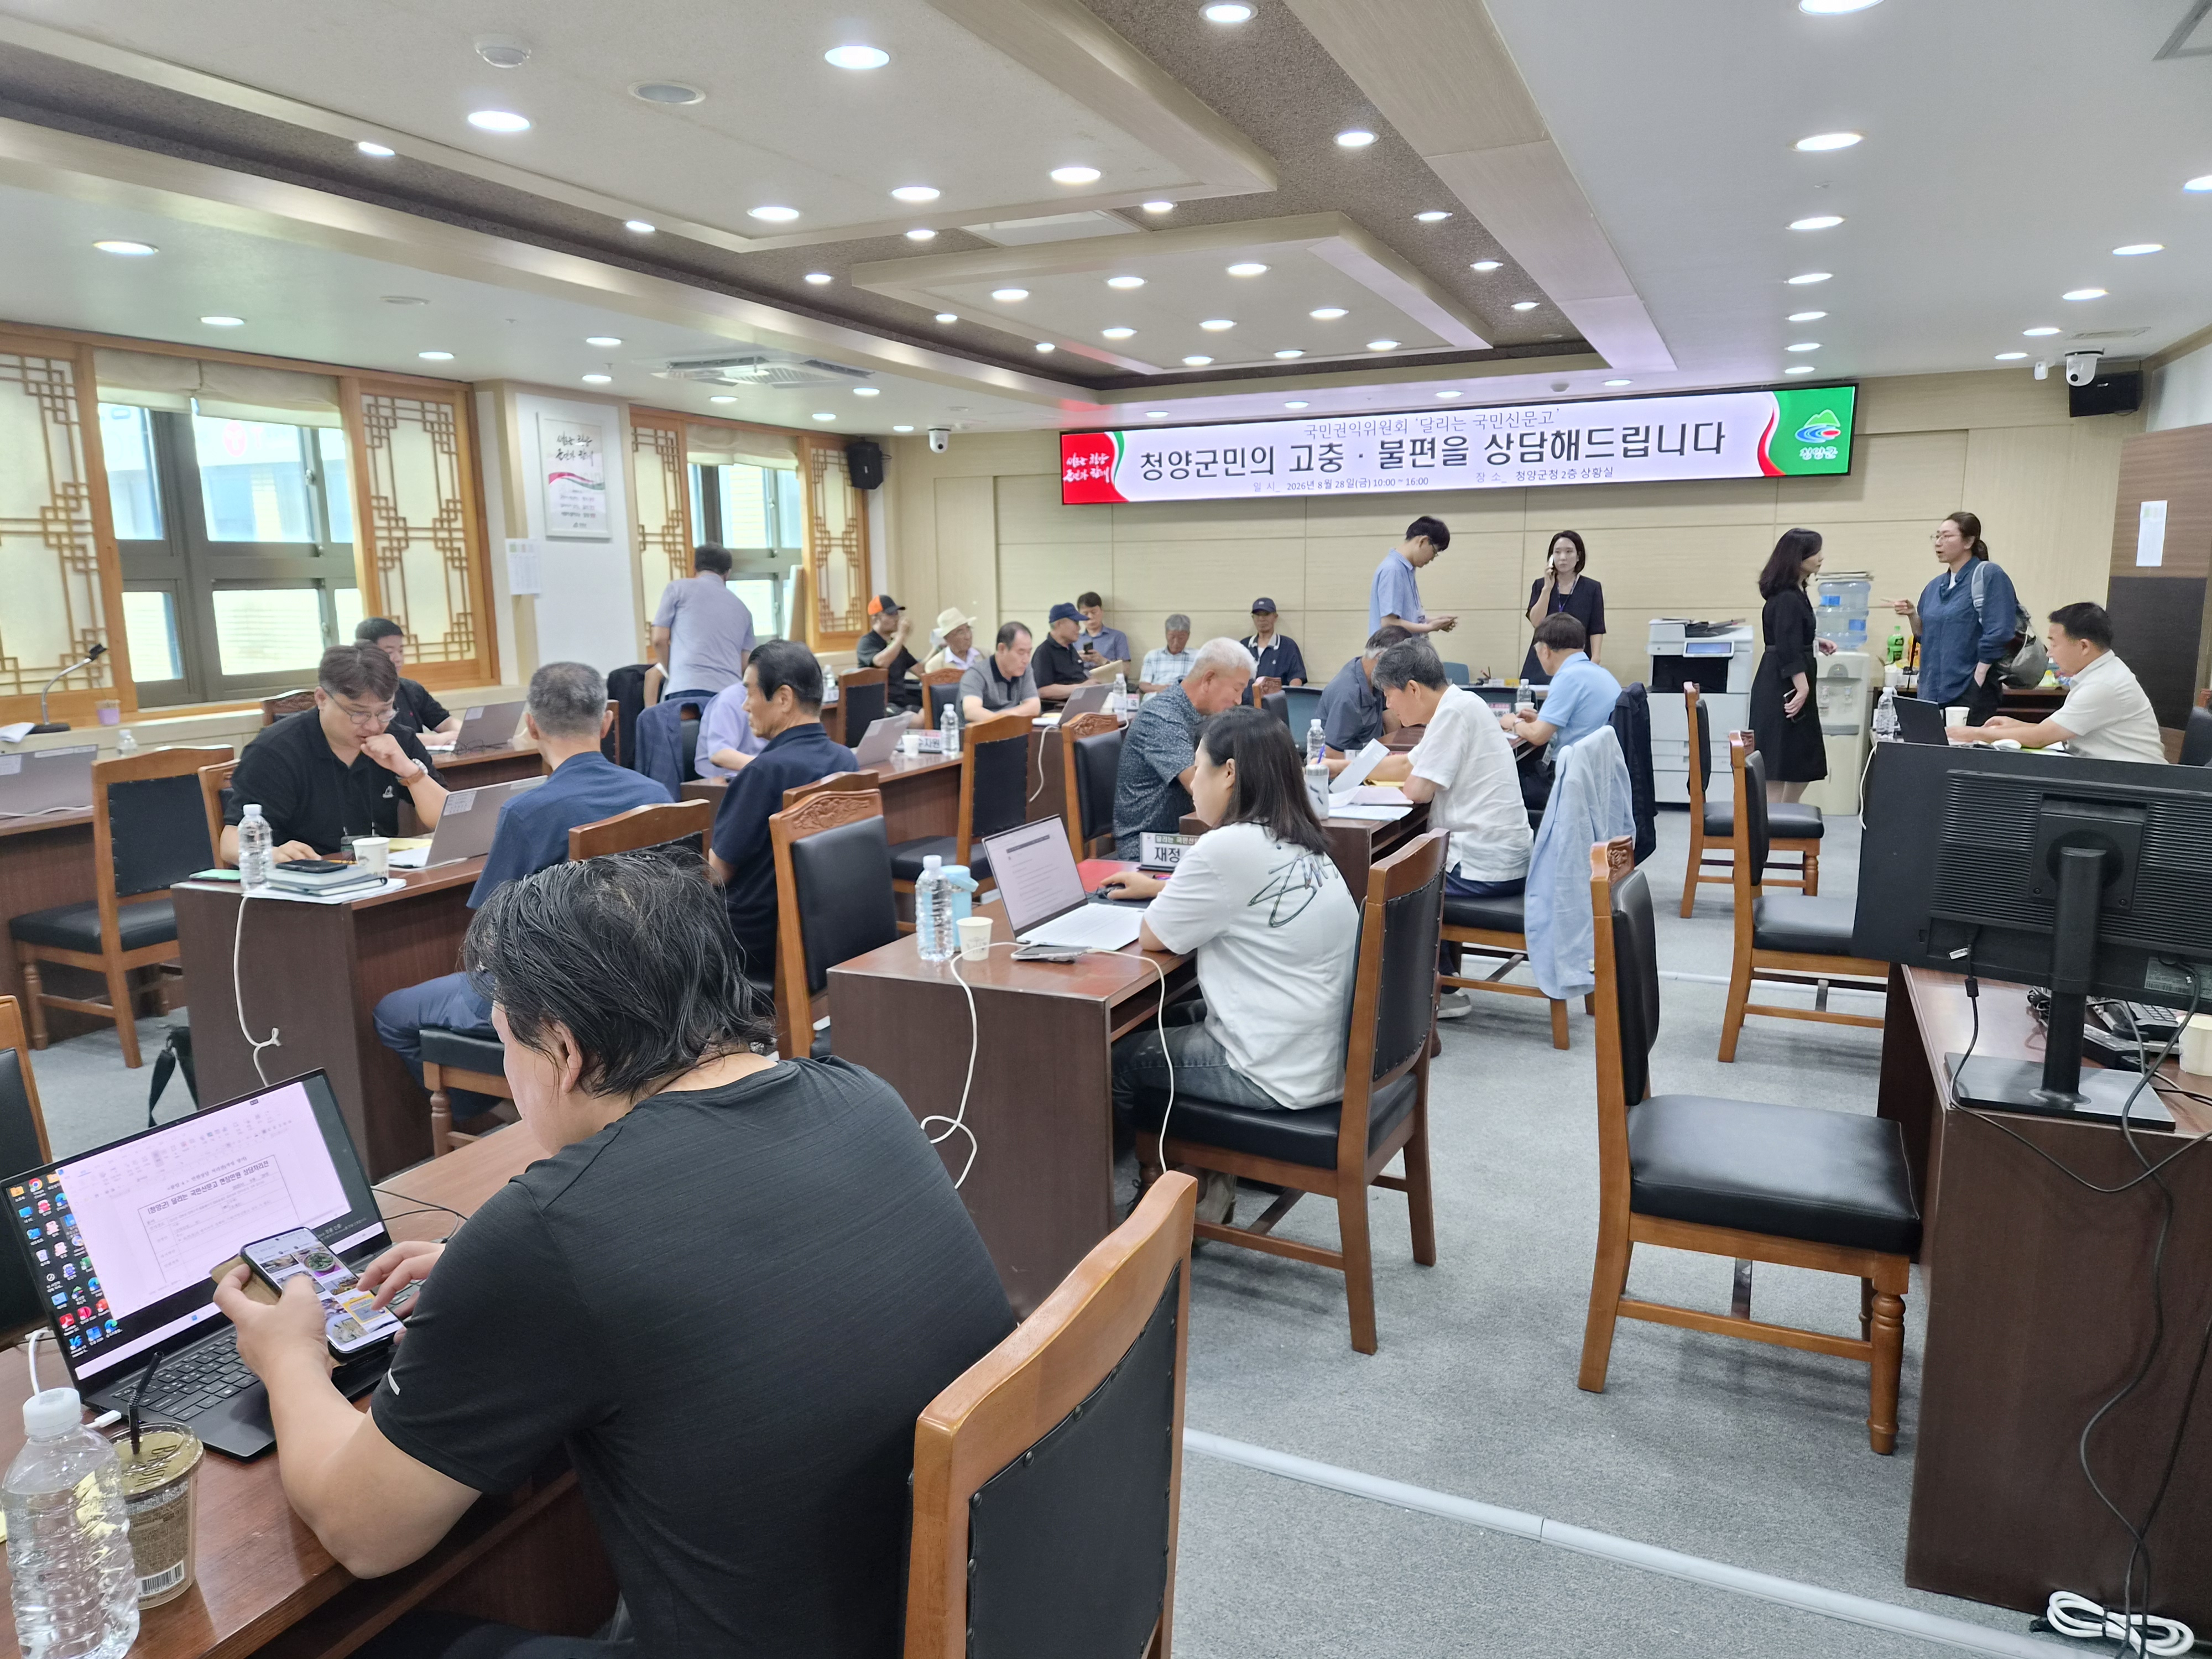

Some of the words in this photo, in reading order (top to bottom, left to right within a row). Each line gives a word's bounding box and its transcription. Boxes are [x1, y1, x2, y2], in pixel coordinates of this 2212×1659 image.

[1304, 418, 1407, 440] 국민권익위원회
[1140, 445, 1275, 481] 청양군민의
[1289, 441, 1345, 473] 고충
[1378, 435, 1470, 470] 불편을
[1484, 420, 1726, 466] 상담해드립니다
[1799, 446, 1839, 461] 청양군
[1516, 469, 1559, 482] 청양군청
[1562, 468, 1577, 480] 2층
[1580, 466, 1614, 479] 상황실
[1287, 480, 1314, 491] 2026년
[1317, 479, 1332, 489] 8월
[1335, 477, 1371, 489] 28일(금)
[1374, 478, 1396, 487] 10:00
[1406, 477, 1429, 486] 16:00
[1156, 835, 1173, 843] 달리는
[171, 1193, 189, 1205] 달리는
[190, 1181, 218, 1197] 국민신문고
[220, 1171, 242, 1185] 현장민원
[135, 1444, 178, 1488] BAISTA
